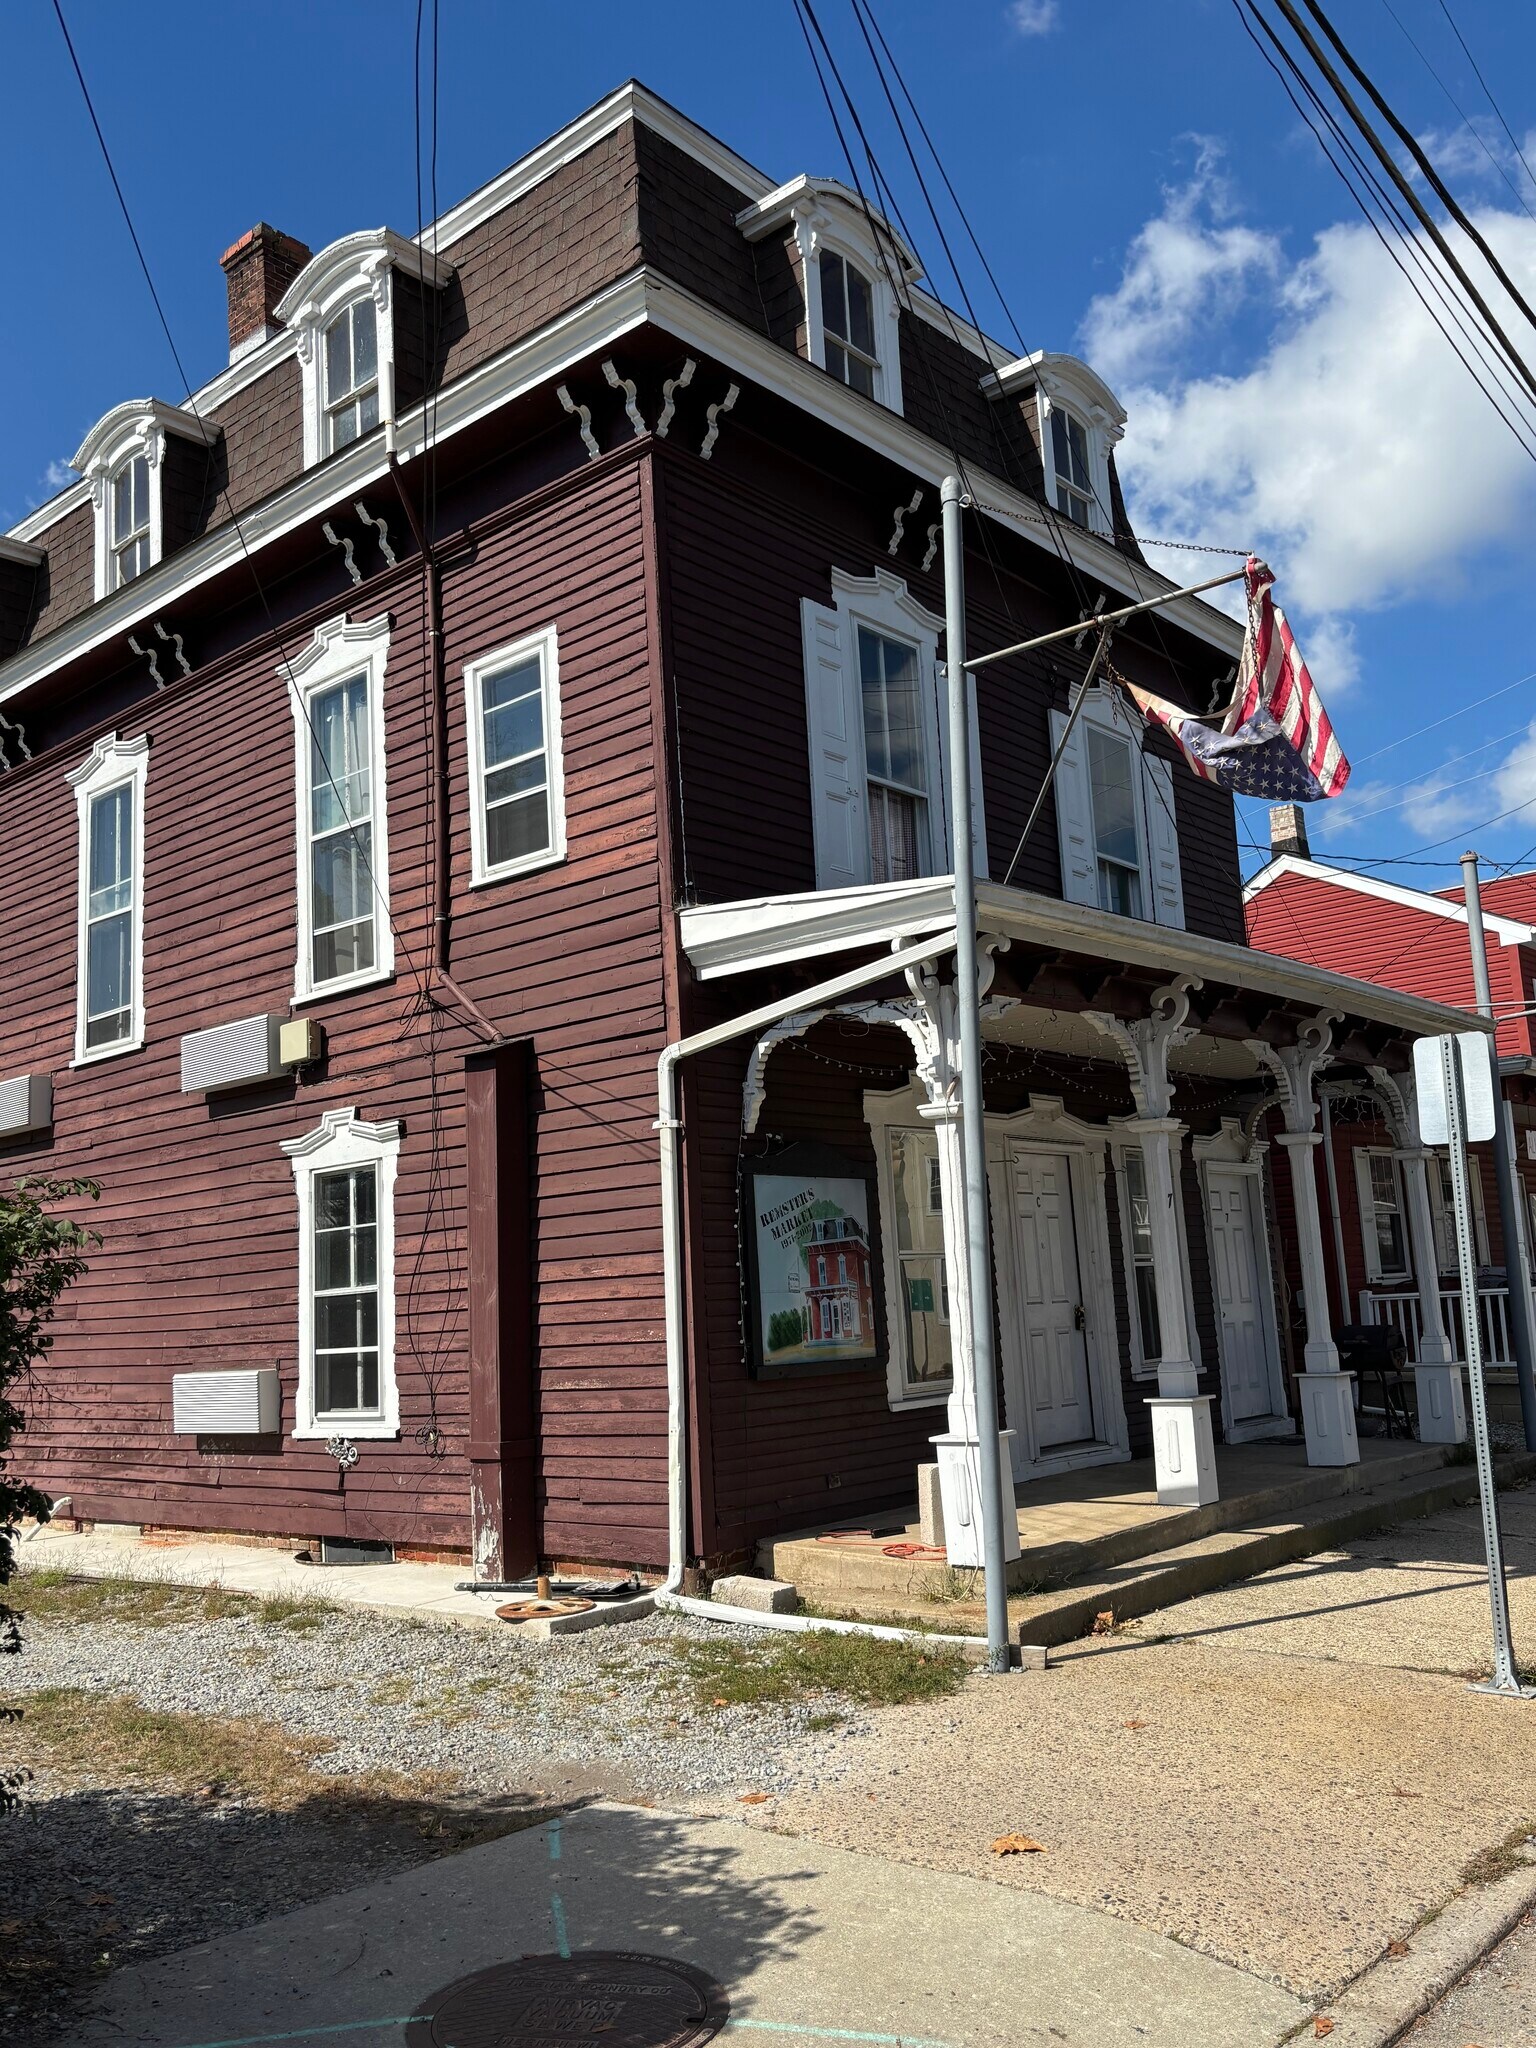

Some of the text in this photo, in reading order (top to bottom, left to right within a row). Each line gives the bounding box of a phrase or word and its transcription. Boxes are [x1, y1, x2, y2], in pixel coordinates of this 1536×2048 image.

[1036, 1196, 1041, 1208] C
[770, 1206, 814, 1240] MARKET
[579, 1981, 647, 1993] FOUNDRY
